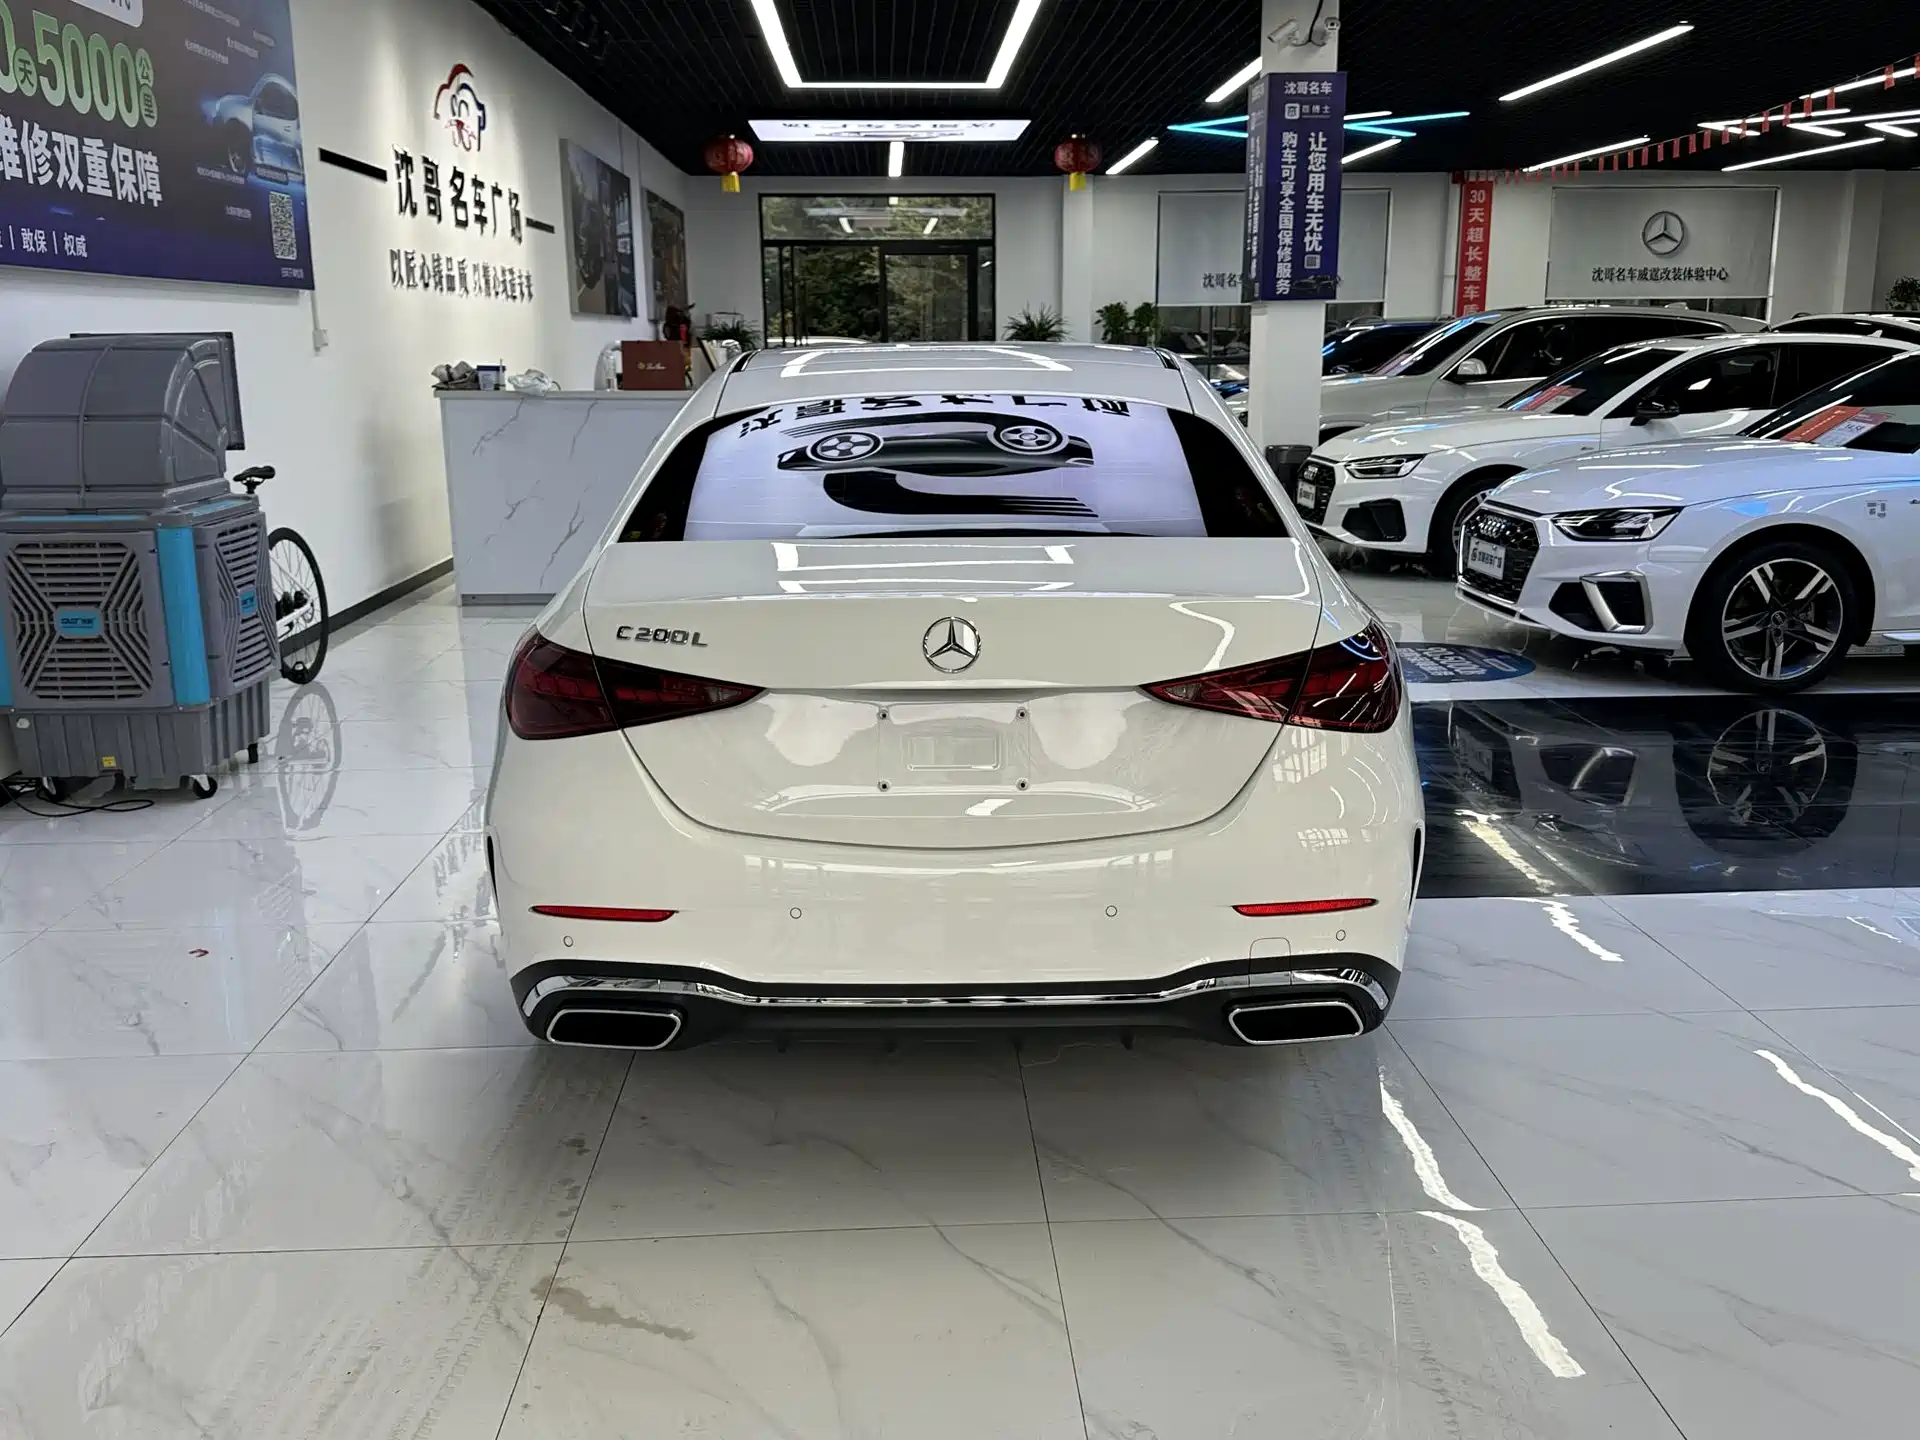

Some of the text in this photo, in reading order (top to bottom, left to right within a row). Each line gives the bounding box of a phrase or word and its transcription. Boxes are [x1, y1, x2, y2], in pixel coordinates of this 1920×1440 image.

[1284, 81, 1333, 95] 沈哥名车
[393, 144, 523, 245] 沈哥名车广场
[1276, 132, 1298, 295] 购车可享全国保修服务
[1304, 132, 1328, 252] 让您用车无忧
[21, 227, 48, 253] 敢保
[63, 231, 88, 258] 权威
[389, 248, 469, 298] 以匠心铸品质
